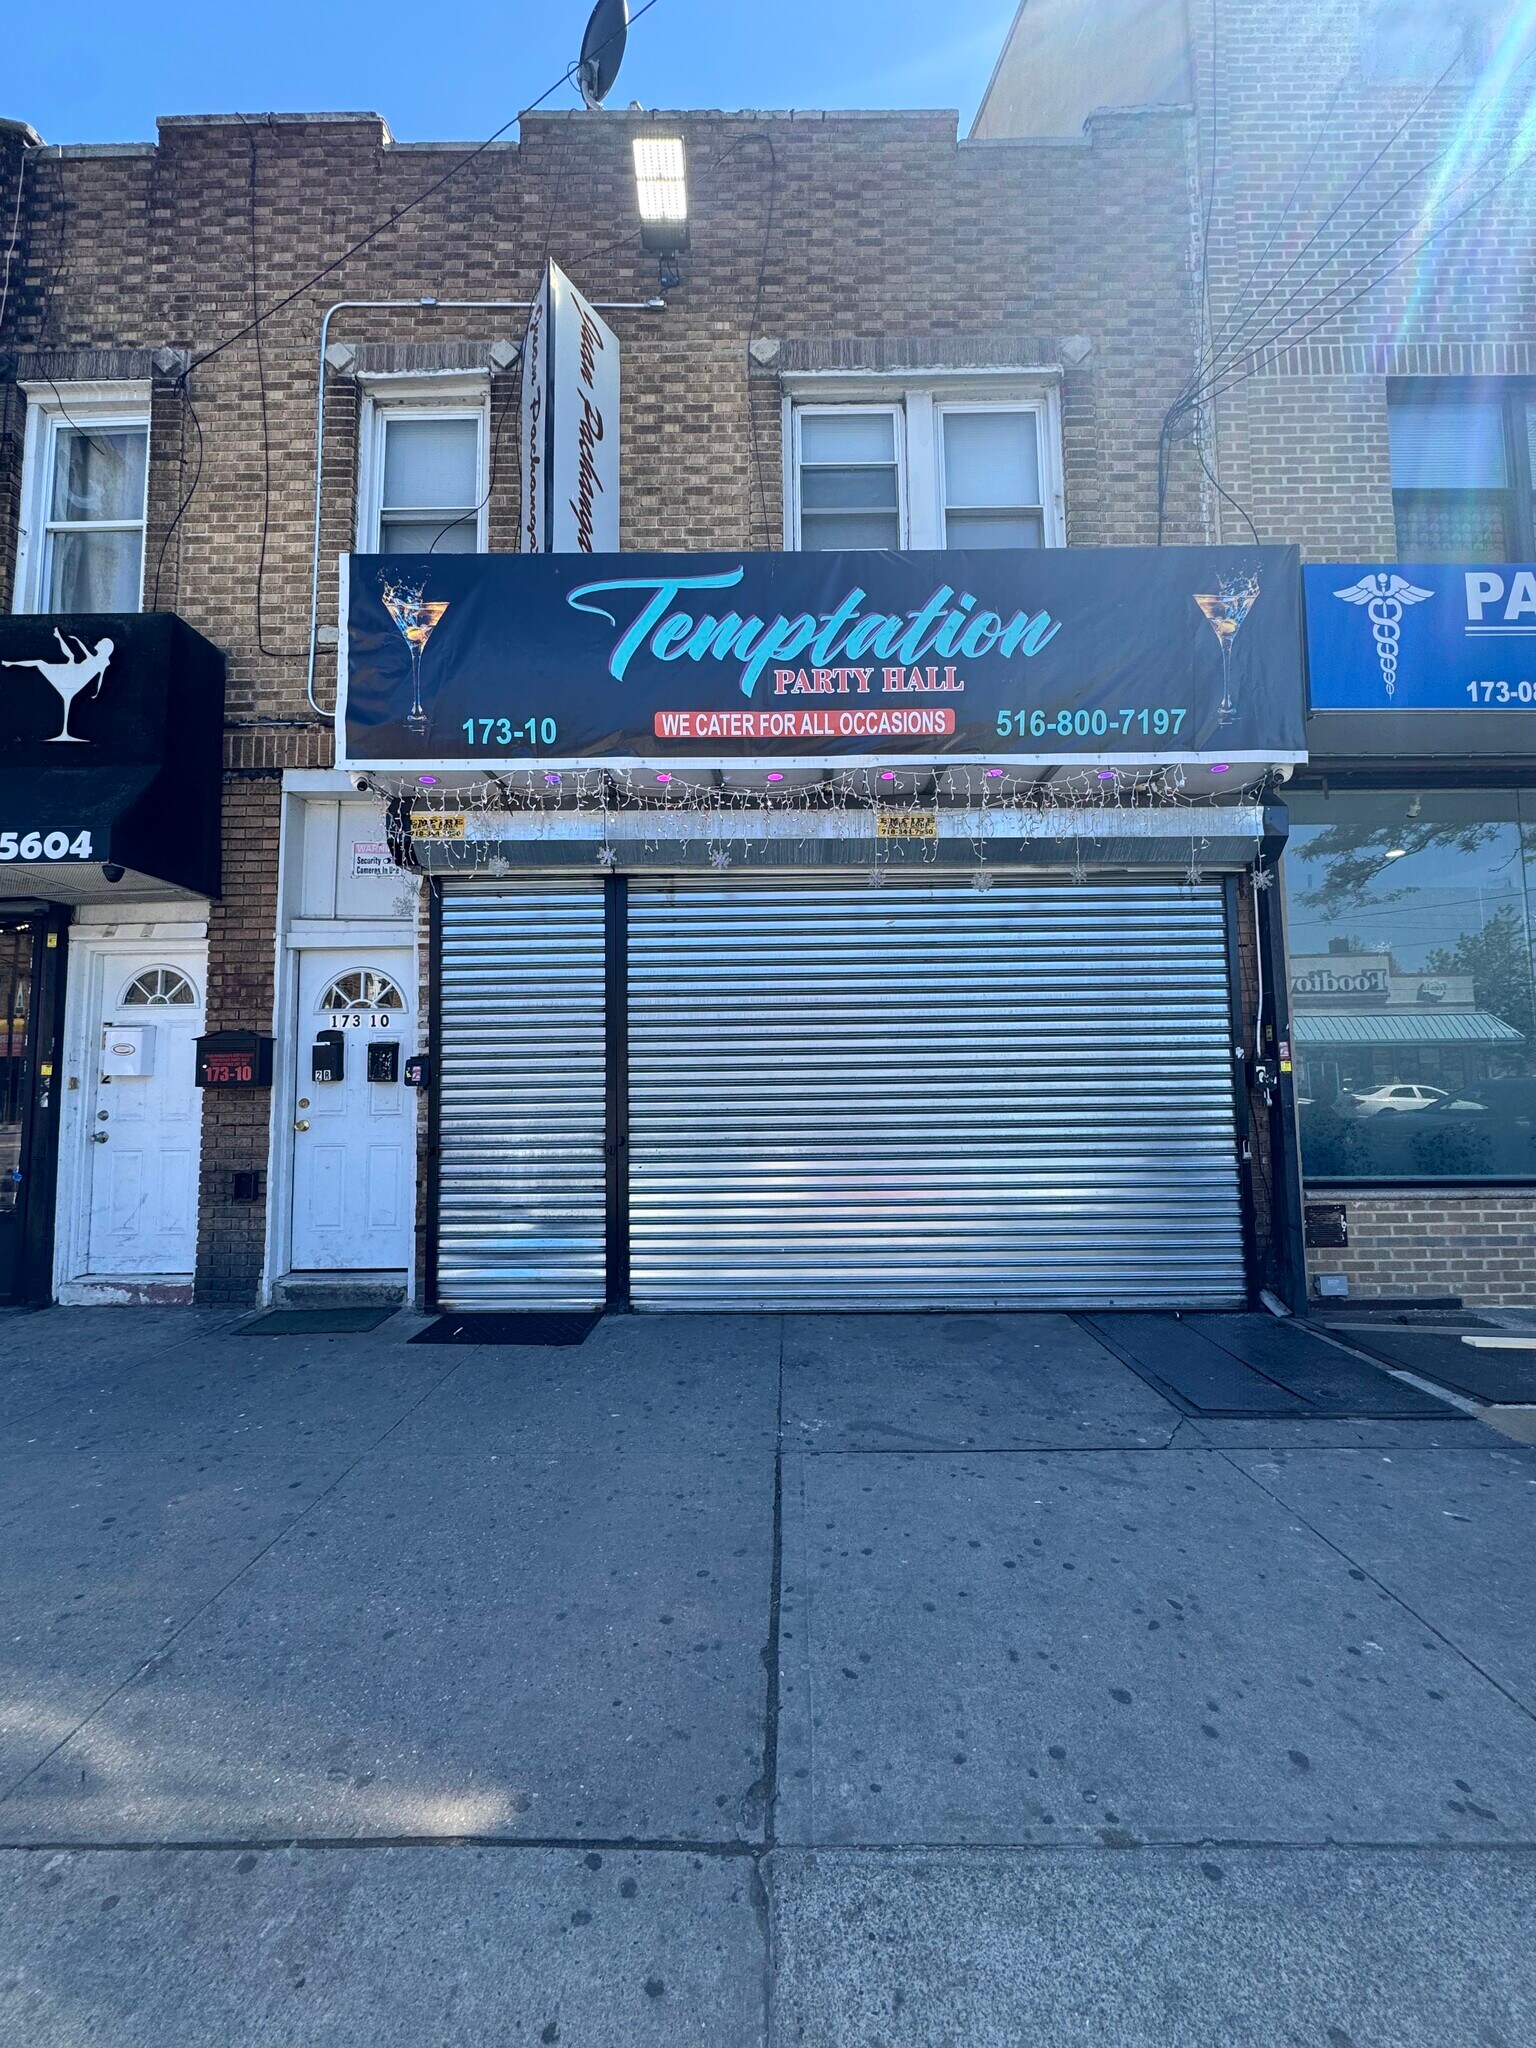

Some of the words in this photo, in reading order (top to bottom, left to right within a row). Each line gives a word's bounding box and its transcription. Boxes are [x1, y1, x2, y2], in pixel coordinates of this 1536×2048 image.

[1464, 571, 1536, 620] PA
[567, 564, 1062, 699] Temptation
[773, 667, 874, 695] PARTY
[882, 666, 965, 694] HALL
[1466, 680, 1536, 703] 173-0
[462, 717, 557, 745] 173-10
[661, 713, 691, 736] WE
[695, 713, 755, 736] CATER
[760, 713, 797, 735] FOR
[800, 712, 835, 735] ALL
[839, 710, 946, 734] OCCASIONS
[996, 708, 1187, 737] 516-800-7197
[0, 830, 93, 860] 5604
[356, 866, 381, 874] Cameras
[357, 856, 381, 866] Security
[331, 1014, 361, 1028] 173
[370, 1014, 390, 1028] 10
[205, 1065, 252, 1082] 173-10
